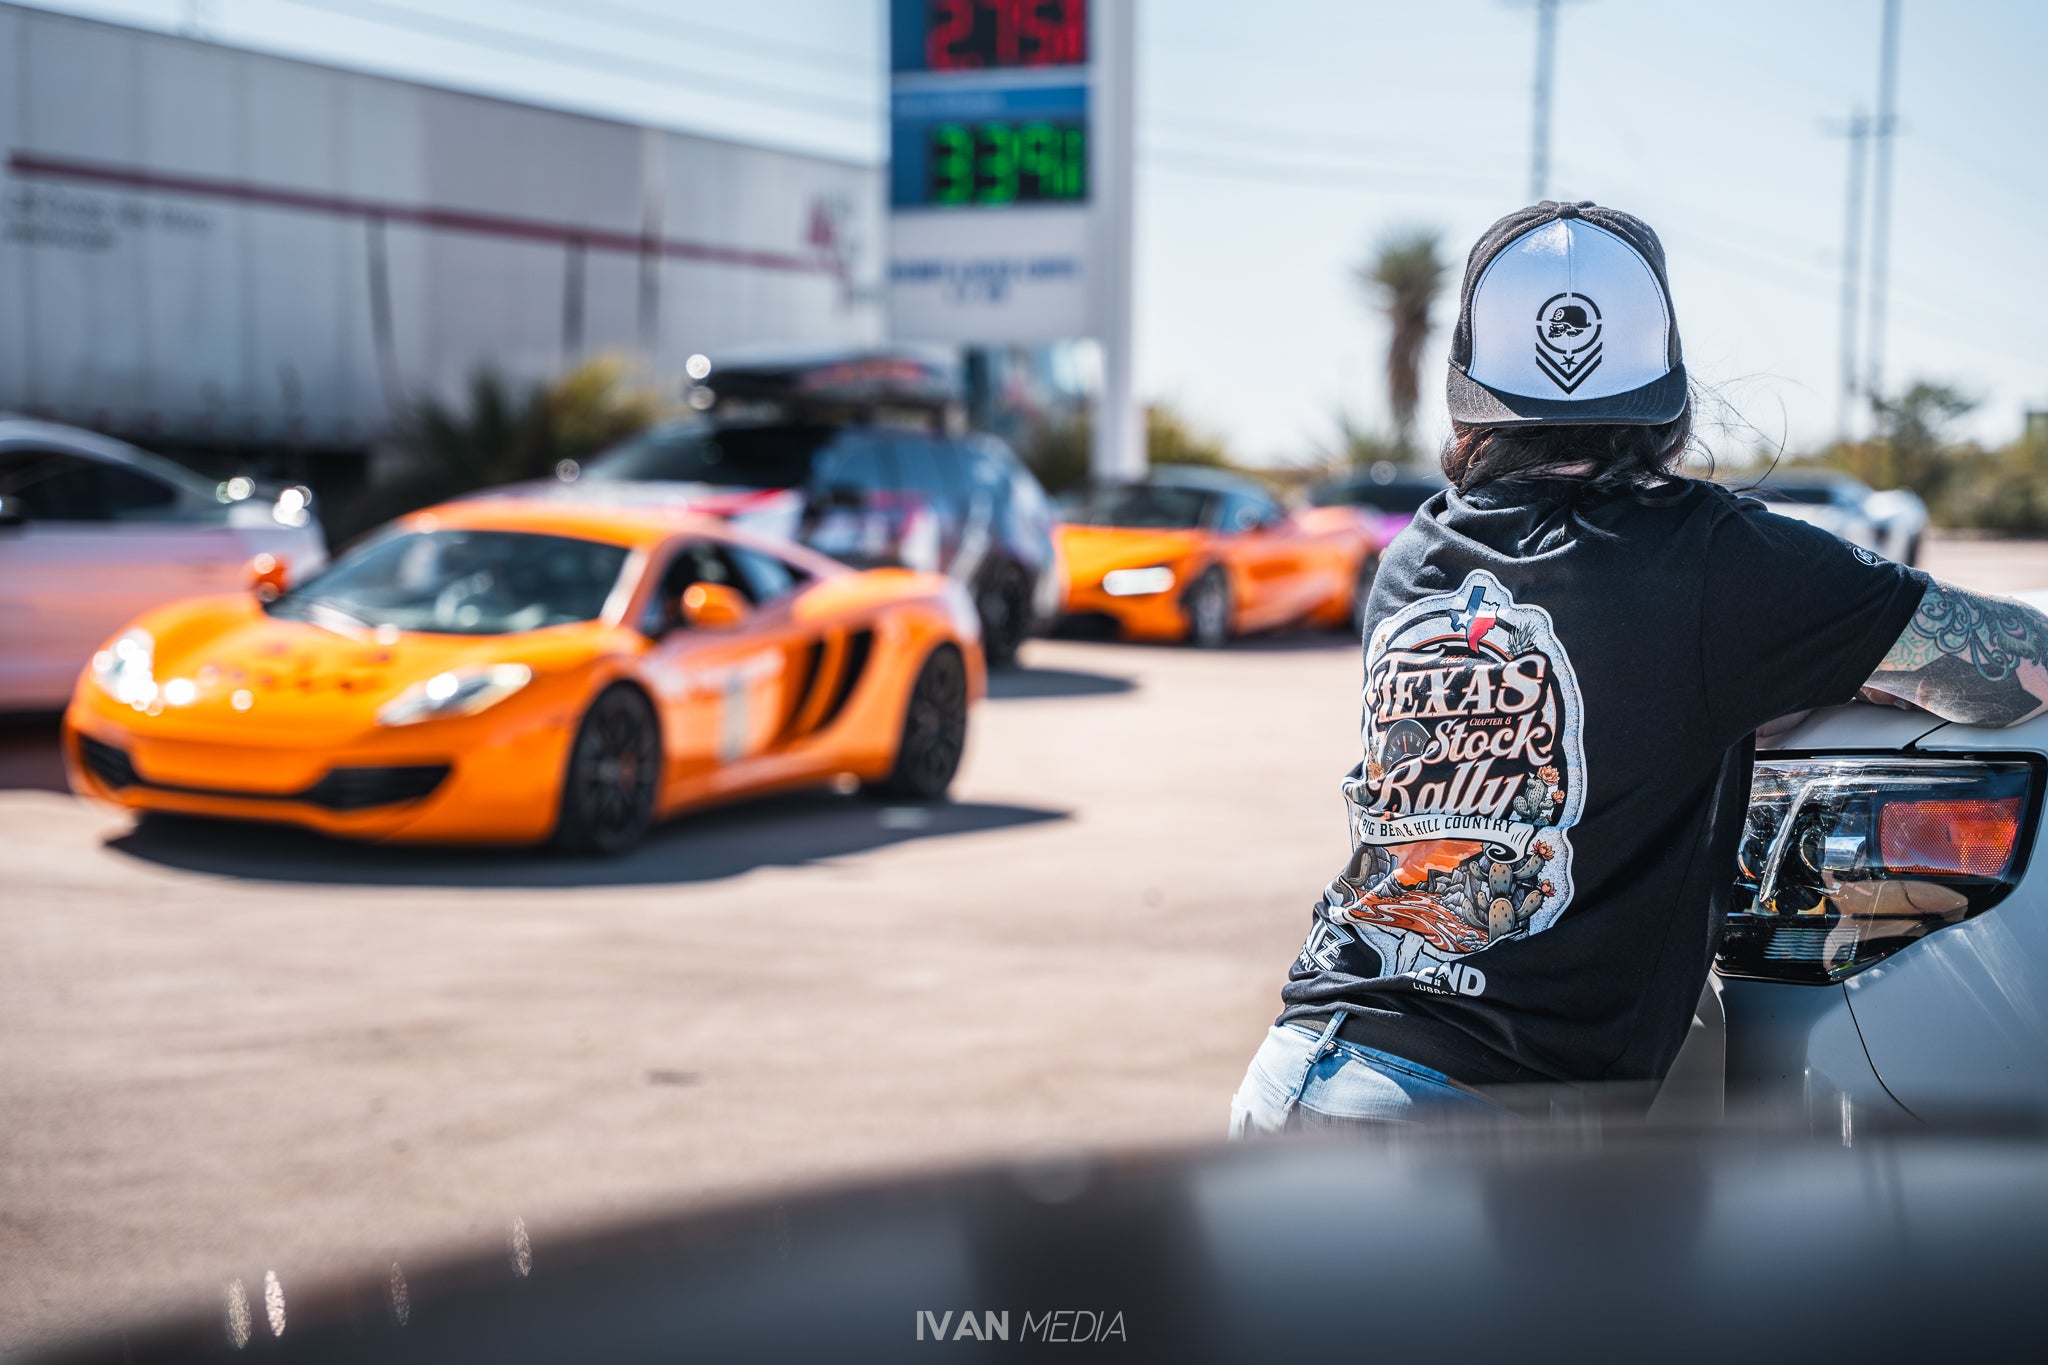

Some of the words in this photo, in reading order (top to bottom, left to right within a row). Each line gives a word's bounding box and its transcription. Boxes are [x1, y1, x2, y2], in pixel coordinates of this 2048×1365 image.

[1371, 647, 1547, 724] TEXAS
[1421, 711, 1553, 766] Stock
[1469, 717, 1503, 726] CHAPTER
[1504, 716, 1512, 725] 8
[1368, 757, 1525, 818] Rally
[1413, 818, 1441, 836] HILL
[1445, 816, 1515, 834] COUNTRY
